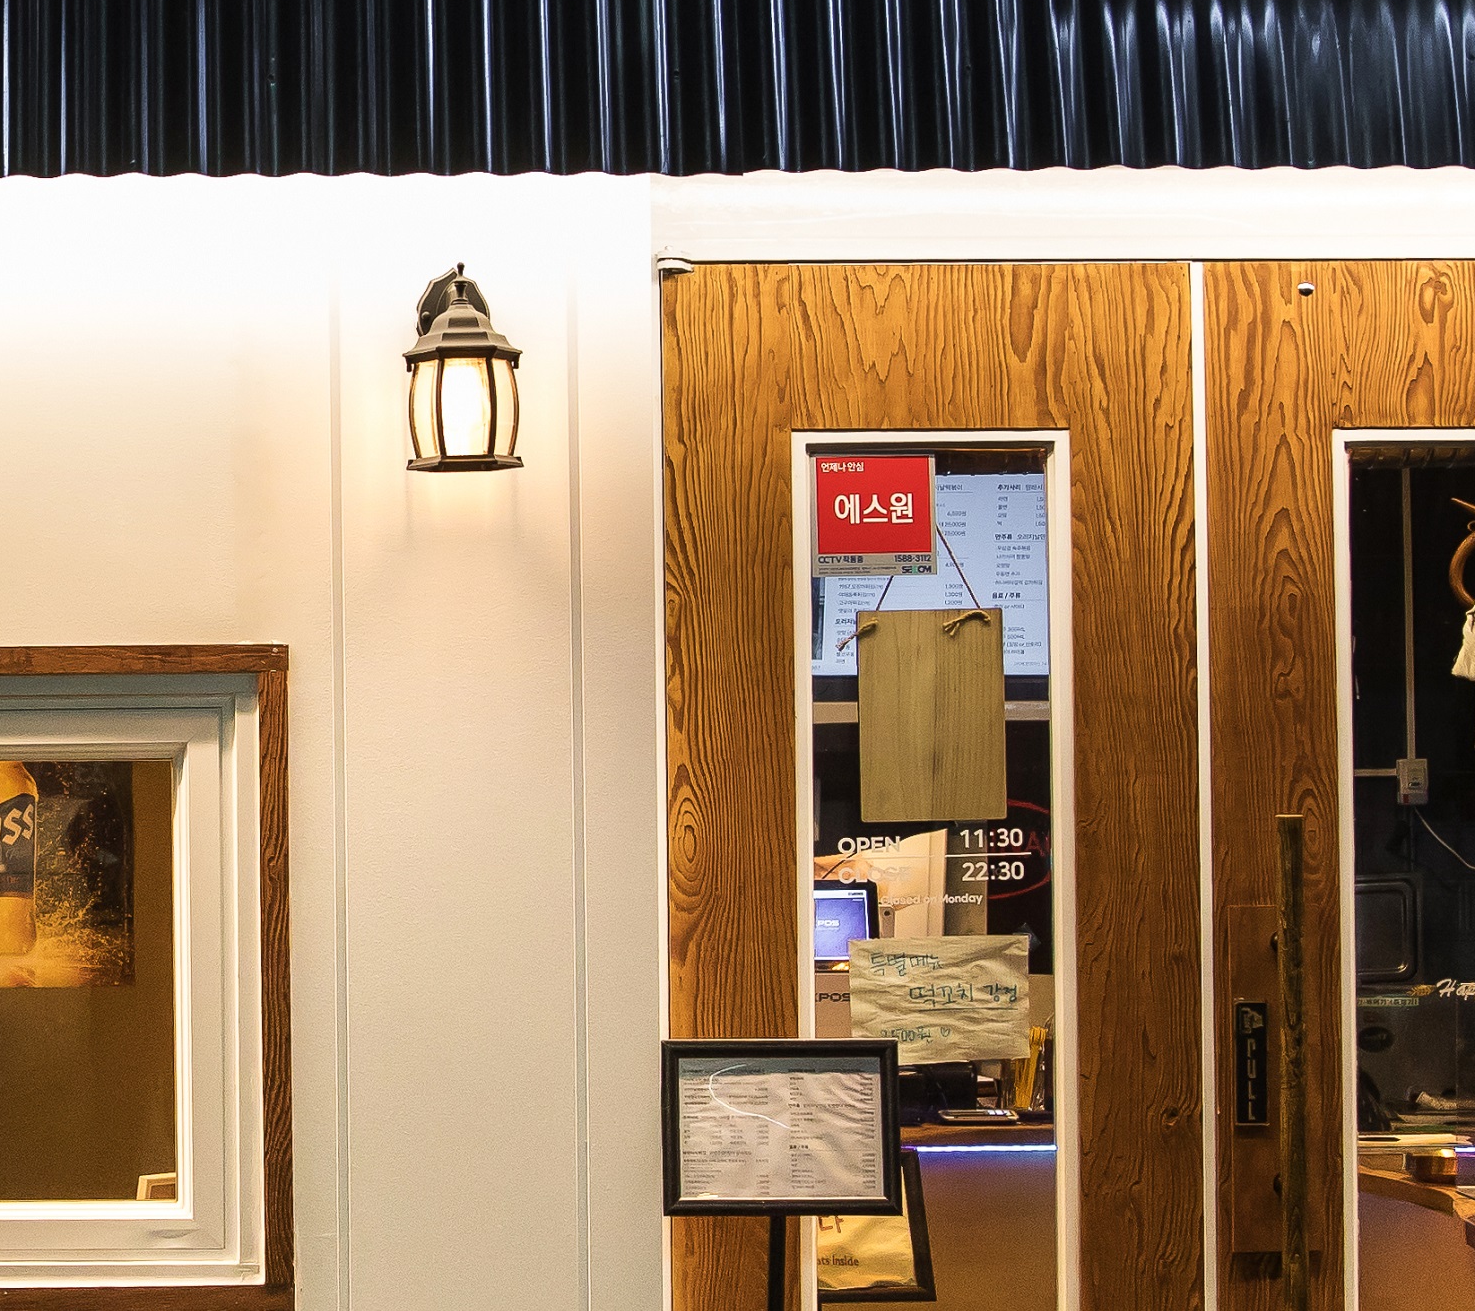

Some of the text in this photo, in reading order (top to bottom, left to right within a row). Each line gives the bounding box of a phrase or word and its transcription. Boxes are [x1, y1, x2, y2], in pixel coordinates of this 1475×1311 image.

[821, 462, 847, 473] 언제나
[834, 493, 914, 524] 에스원
[818, 556, 842, 564] CCTV
[894, 554, 932, 563] 1588-3112
[837, 836, 900, 855] OPEN
[960, 828, 1024, 848] 11:30
[837, 866, 912, 885] CLOSE
[962, 862, 1025, 882] 22:30
[940, 893, 984, 905] Monday
[1247, 1038, 1256, 1120] PULL
